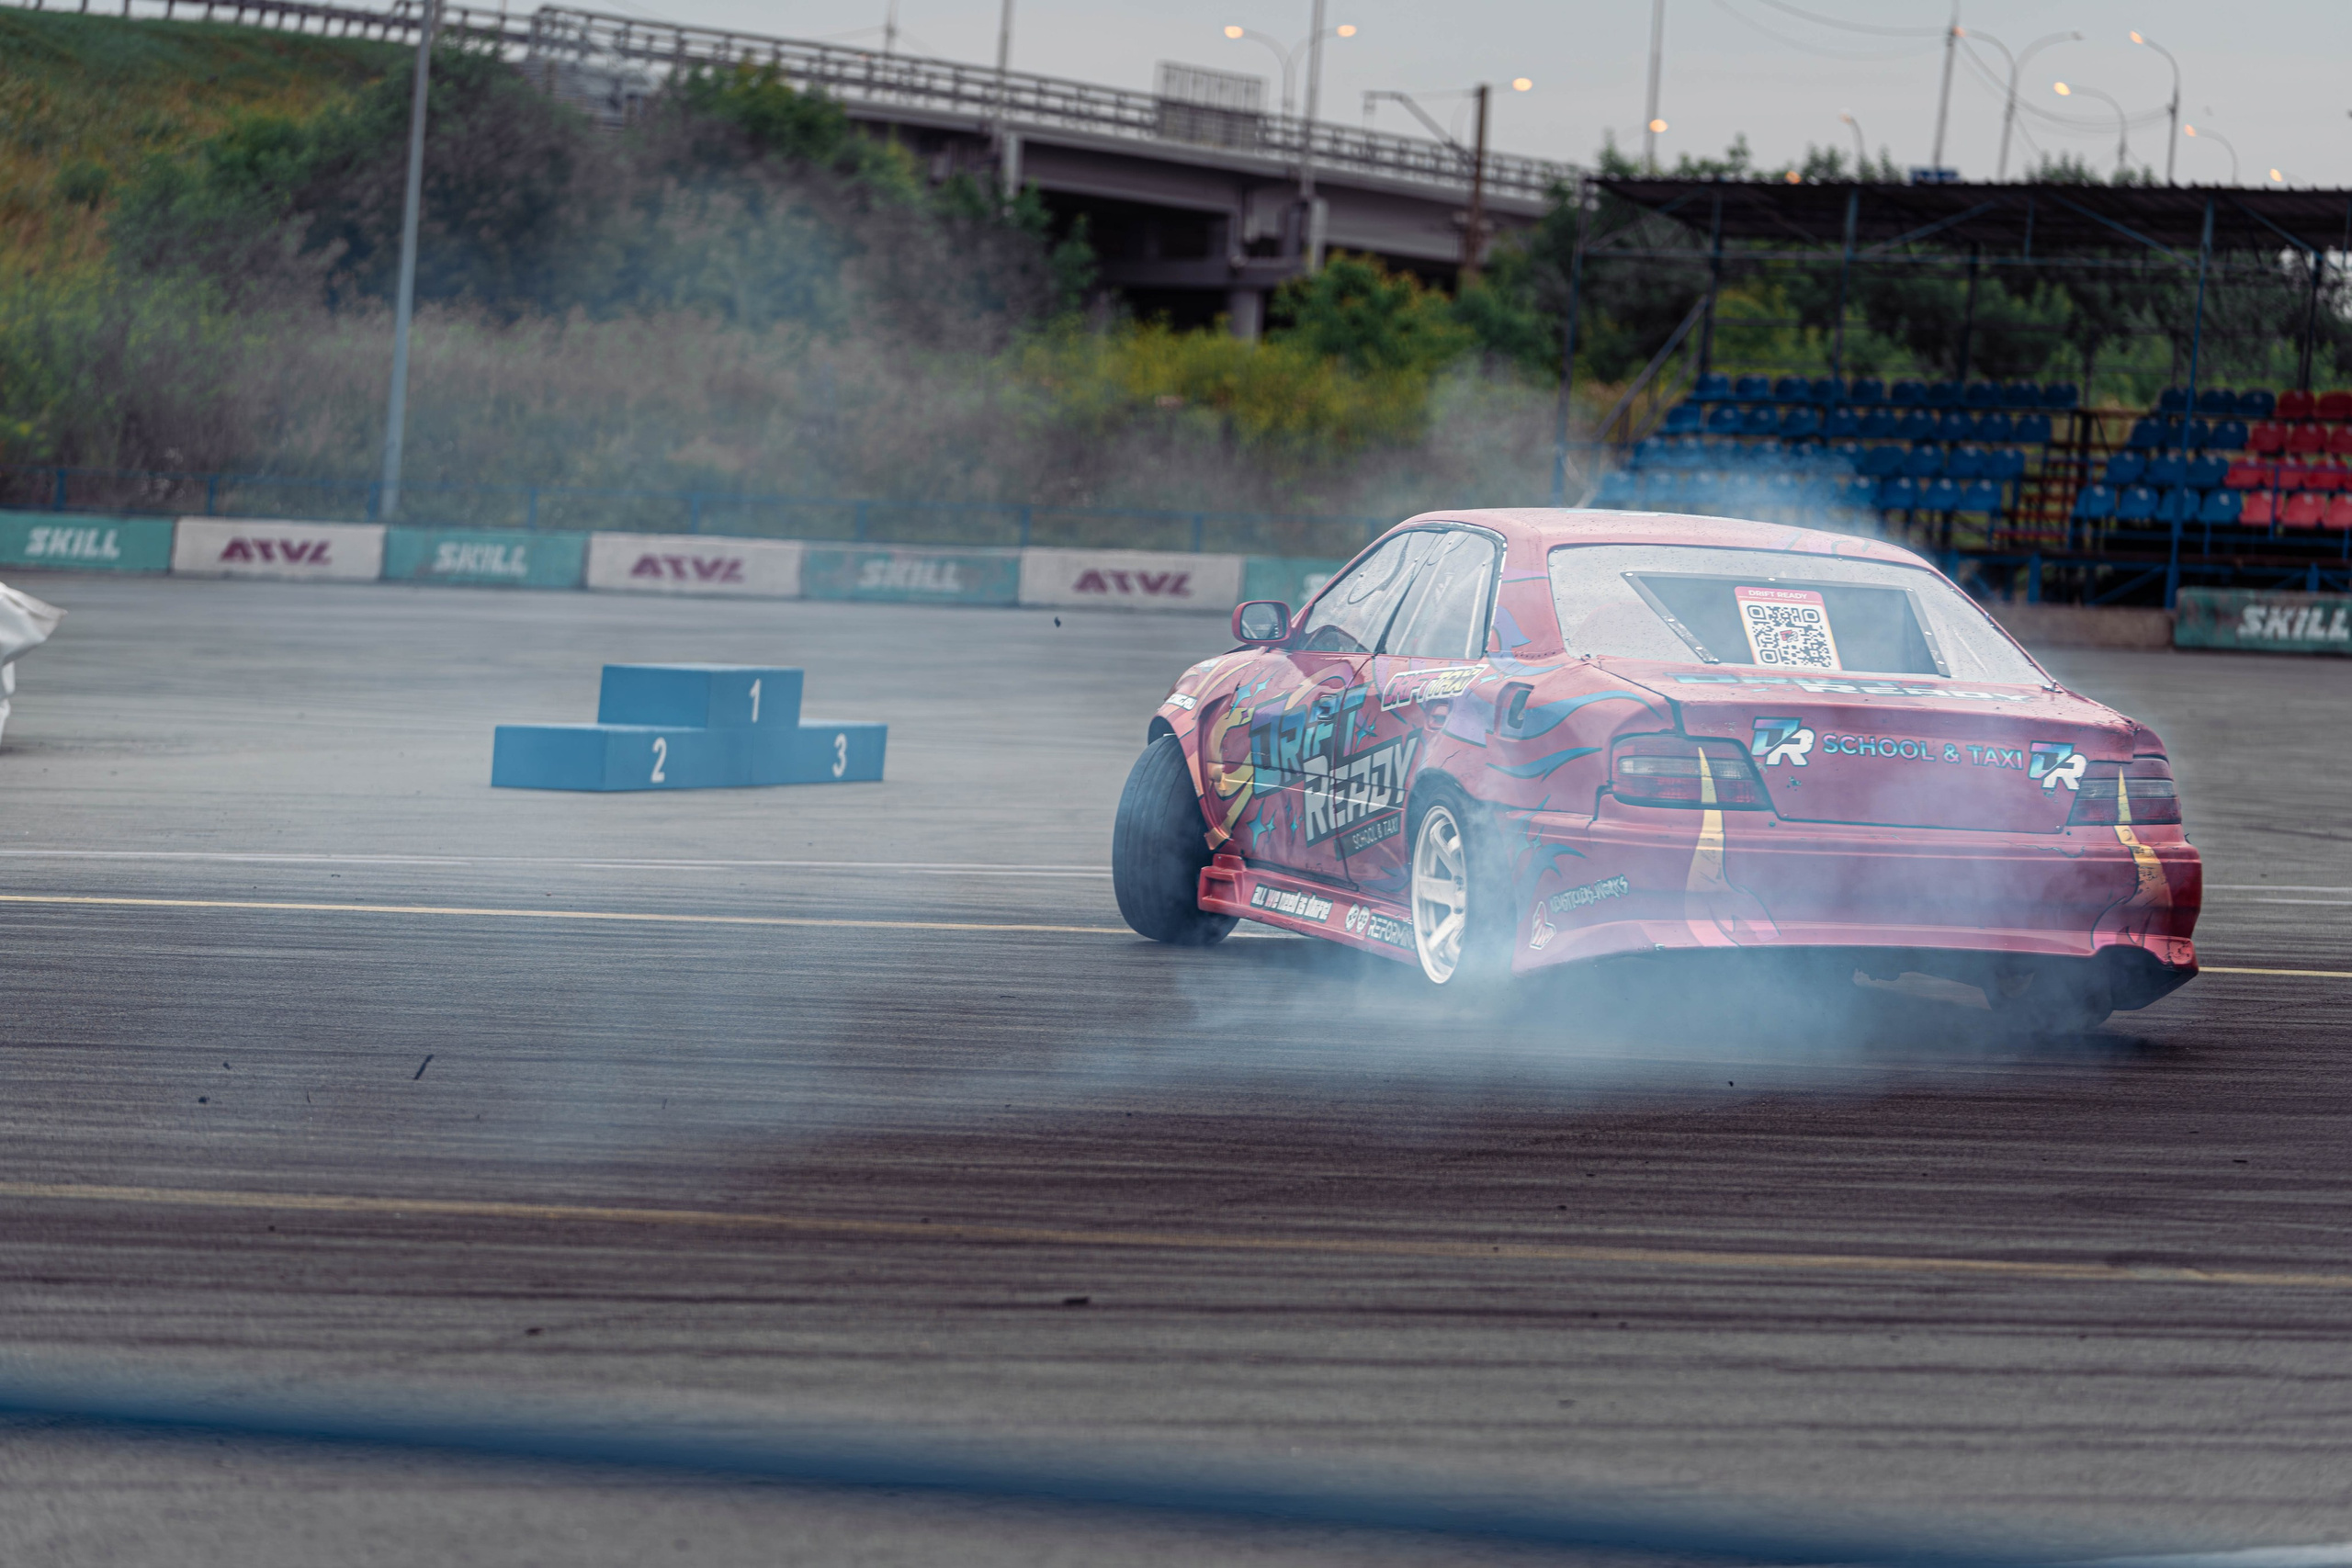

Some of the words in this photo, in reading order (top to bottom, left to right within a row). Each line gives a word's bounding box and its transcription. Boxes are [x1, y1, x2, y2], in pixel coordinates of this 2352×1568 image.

[25, 526, 121, 559] SKILL
[434, 542, 527, 577] SKILL
[2236, 604, 2349, 640] SKILL
[750, 678, 762, 723] 1
[1797, 682, 2031, 702] READY
[832, 733, 847, 778] 3
[1250, 686, 1368, 795] DRIFT
[1823, 734, 1936, 762] SCHOOL
[1943, 743, 1961, 764] &
[1966, 745, 2023, 770] TAXI
[650, 737, 667, 784] 2
[1304, 737, 1418, 841] READY
[1352, 827, 1378, 850] SCHOOL
[1383, 816, 1399, 836] TAXI
